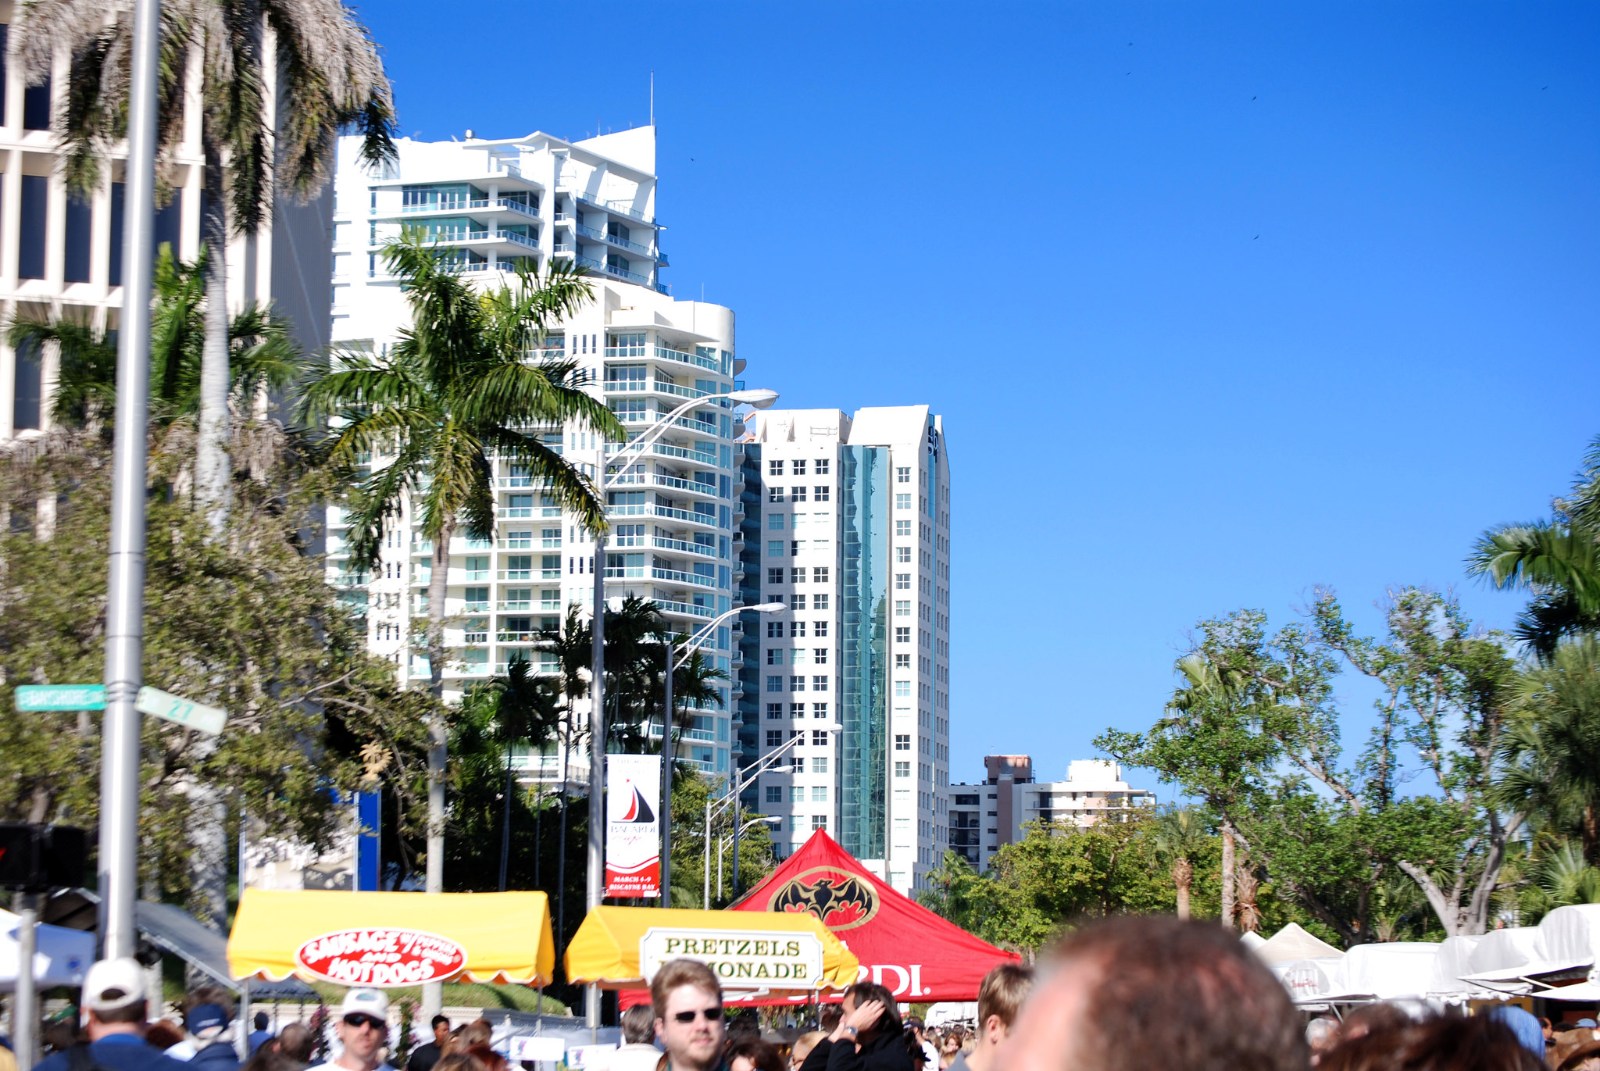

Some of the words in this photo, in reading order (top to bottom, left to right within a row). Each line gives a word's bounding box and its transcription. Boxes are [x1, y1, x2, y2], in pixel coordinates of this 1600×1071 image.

[304, 931, 401, 964] SAUSAGE
[665, 938, 801, 957] PRETZELS
[359, 952, 402, 963] AND
[658, 961, 808, 980] ONADE
